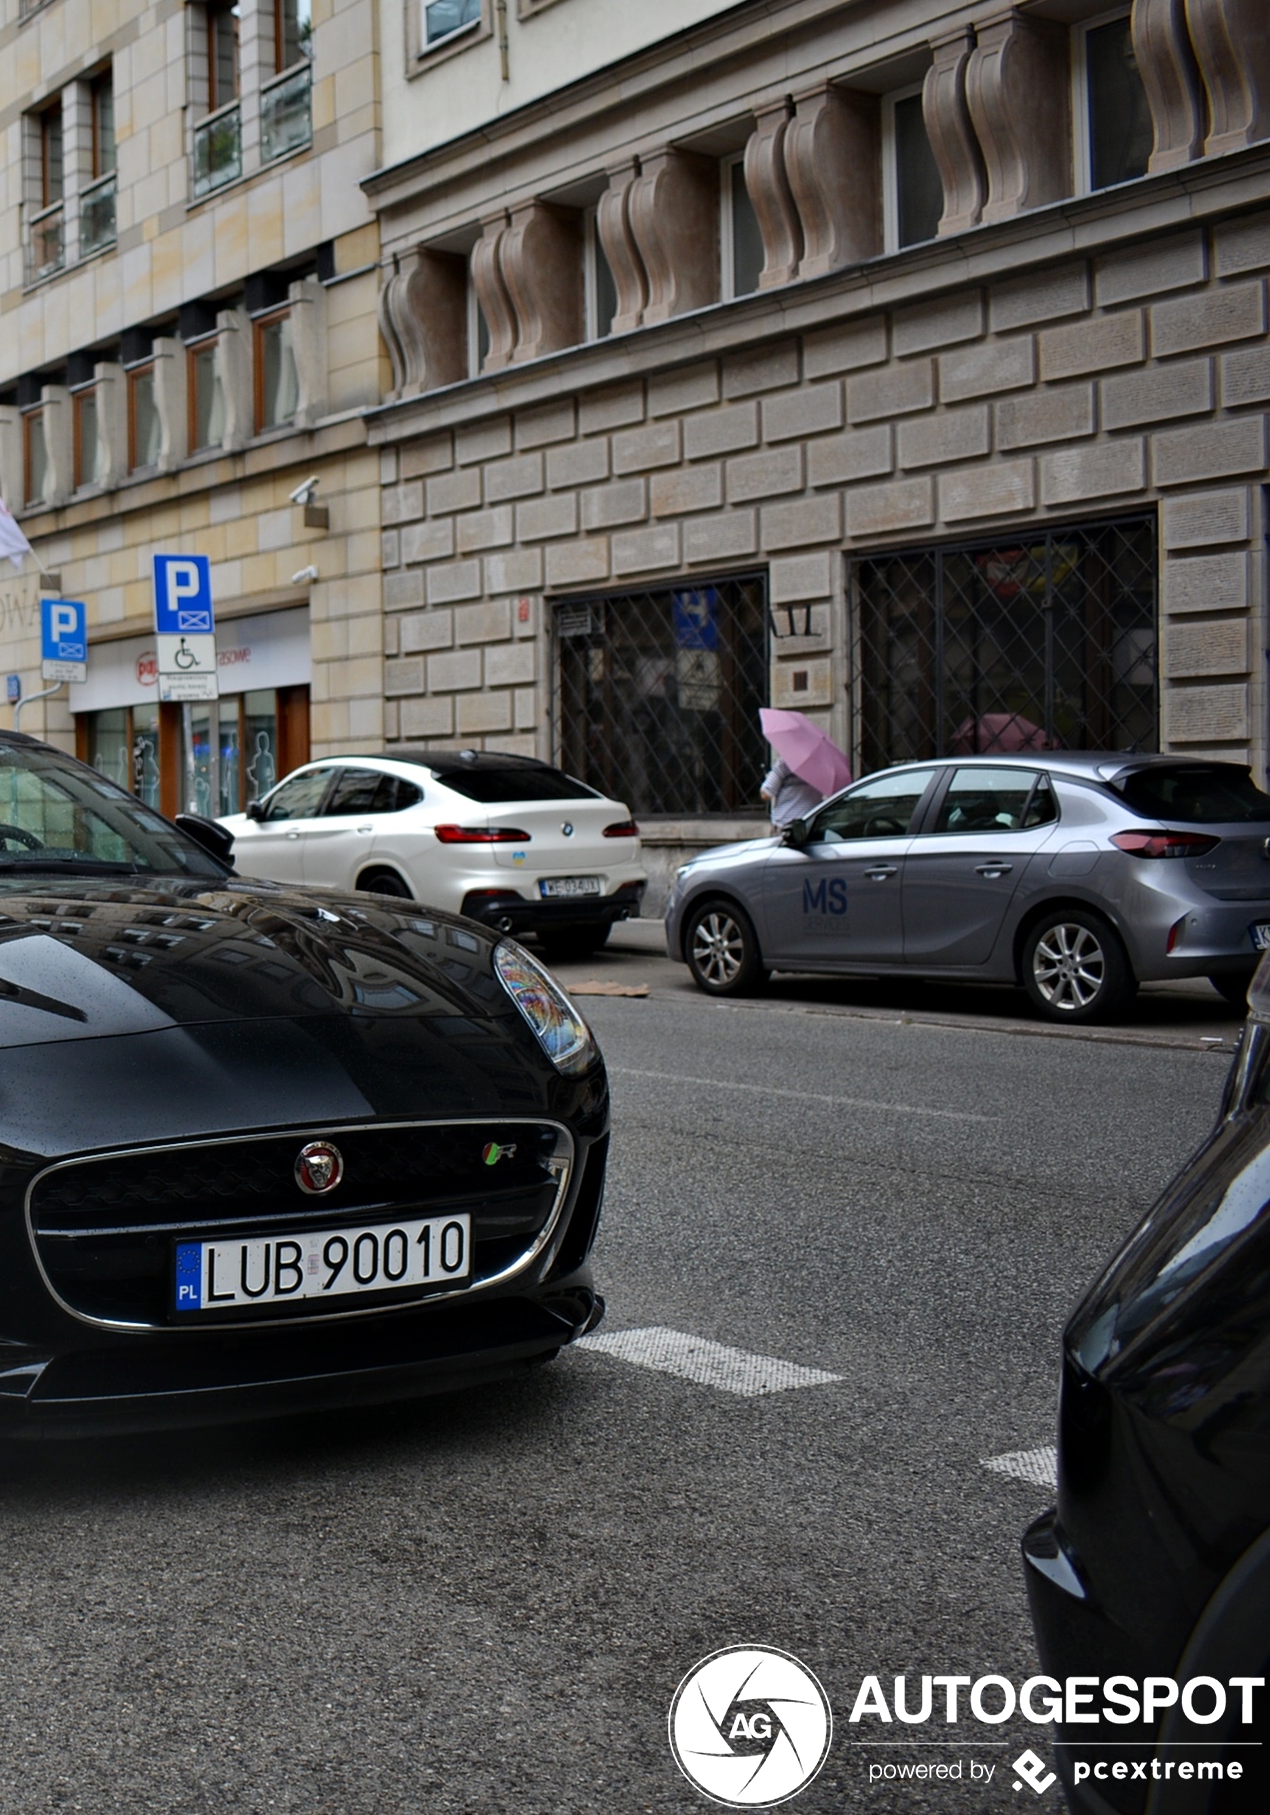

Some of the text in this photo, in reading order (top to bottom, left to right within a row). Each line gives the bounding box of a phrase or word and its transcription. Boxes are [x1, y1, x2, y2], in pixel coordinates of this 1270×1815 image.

[166, 561, 200, 611] P
[51, 604, 78, 642] P
[803, 878, 847, 915] MS
[207, 1220, 465, 1302] LUB 90010
[179, 1285, 197, 1300] PL
